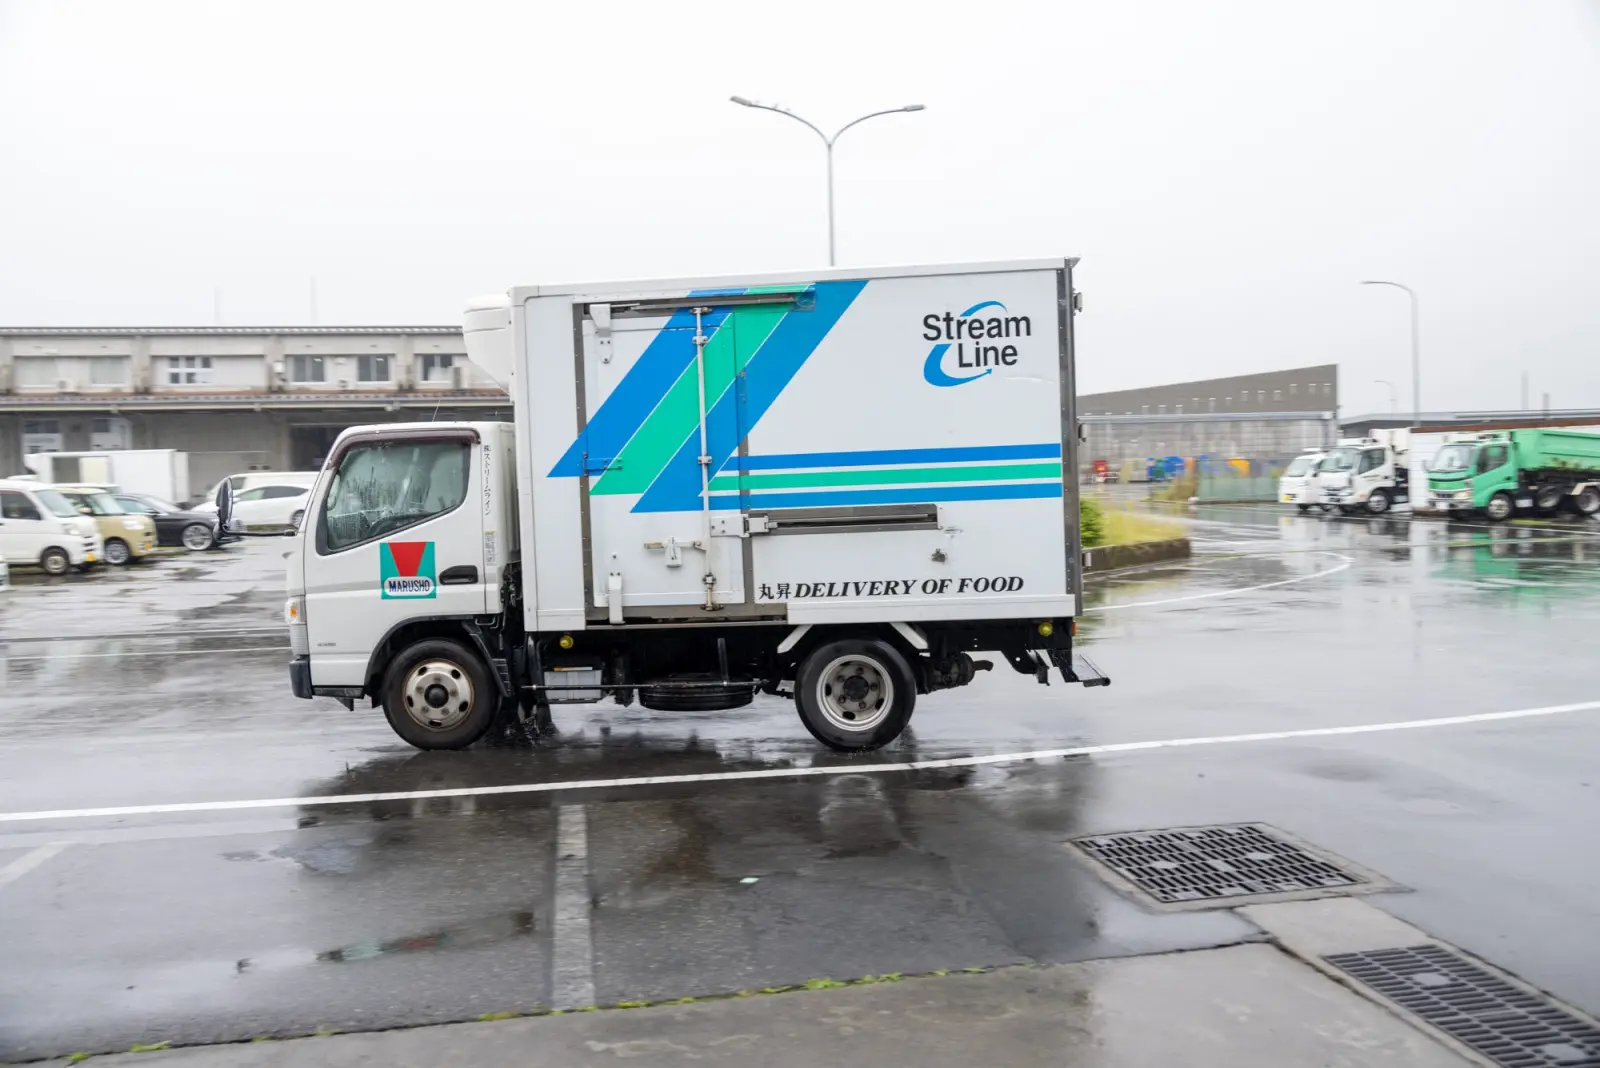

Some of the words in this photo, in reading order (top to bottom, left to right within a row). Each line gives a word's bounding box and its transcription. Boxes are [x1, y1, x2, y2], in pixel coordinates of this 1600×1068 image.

[923, 311, 1031, 341] Stream
[958, 341, 1018, 368] Line
[388, 580, 430, 592] MARUSHO
[794, 579, 918, 598] DELIVERY
[921, 578, 953, 595] OF
[956, 576, 1024, 593] FOOD
